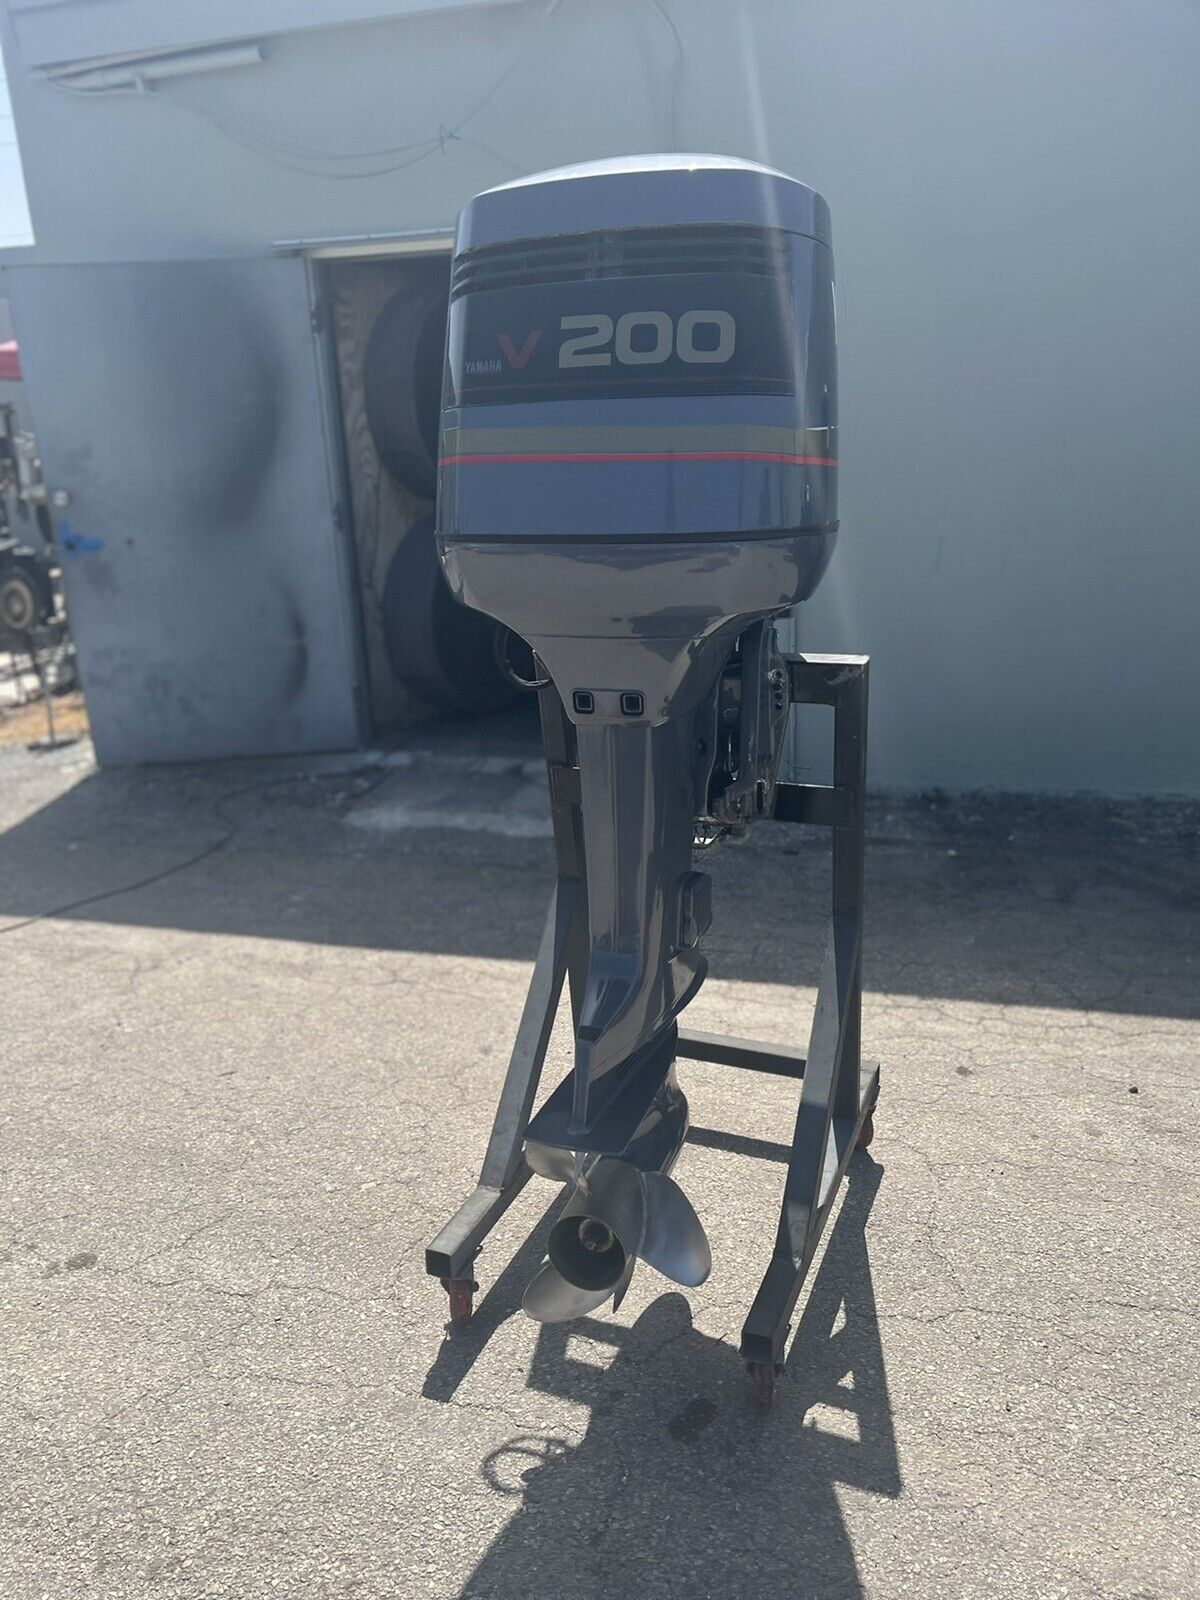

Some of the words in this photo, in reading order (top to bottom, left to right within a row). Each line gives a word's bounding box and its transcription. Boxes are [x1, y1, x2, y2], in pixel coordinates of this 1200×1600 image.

[465, 359, 502, 375] YAMAHA
[500, 330, 542, 369] V
[558, 310, 736, 368] 200
